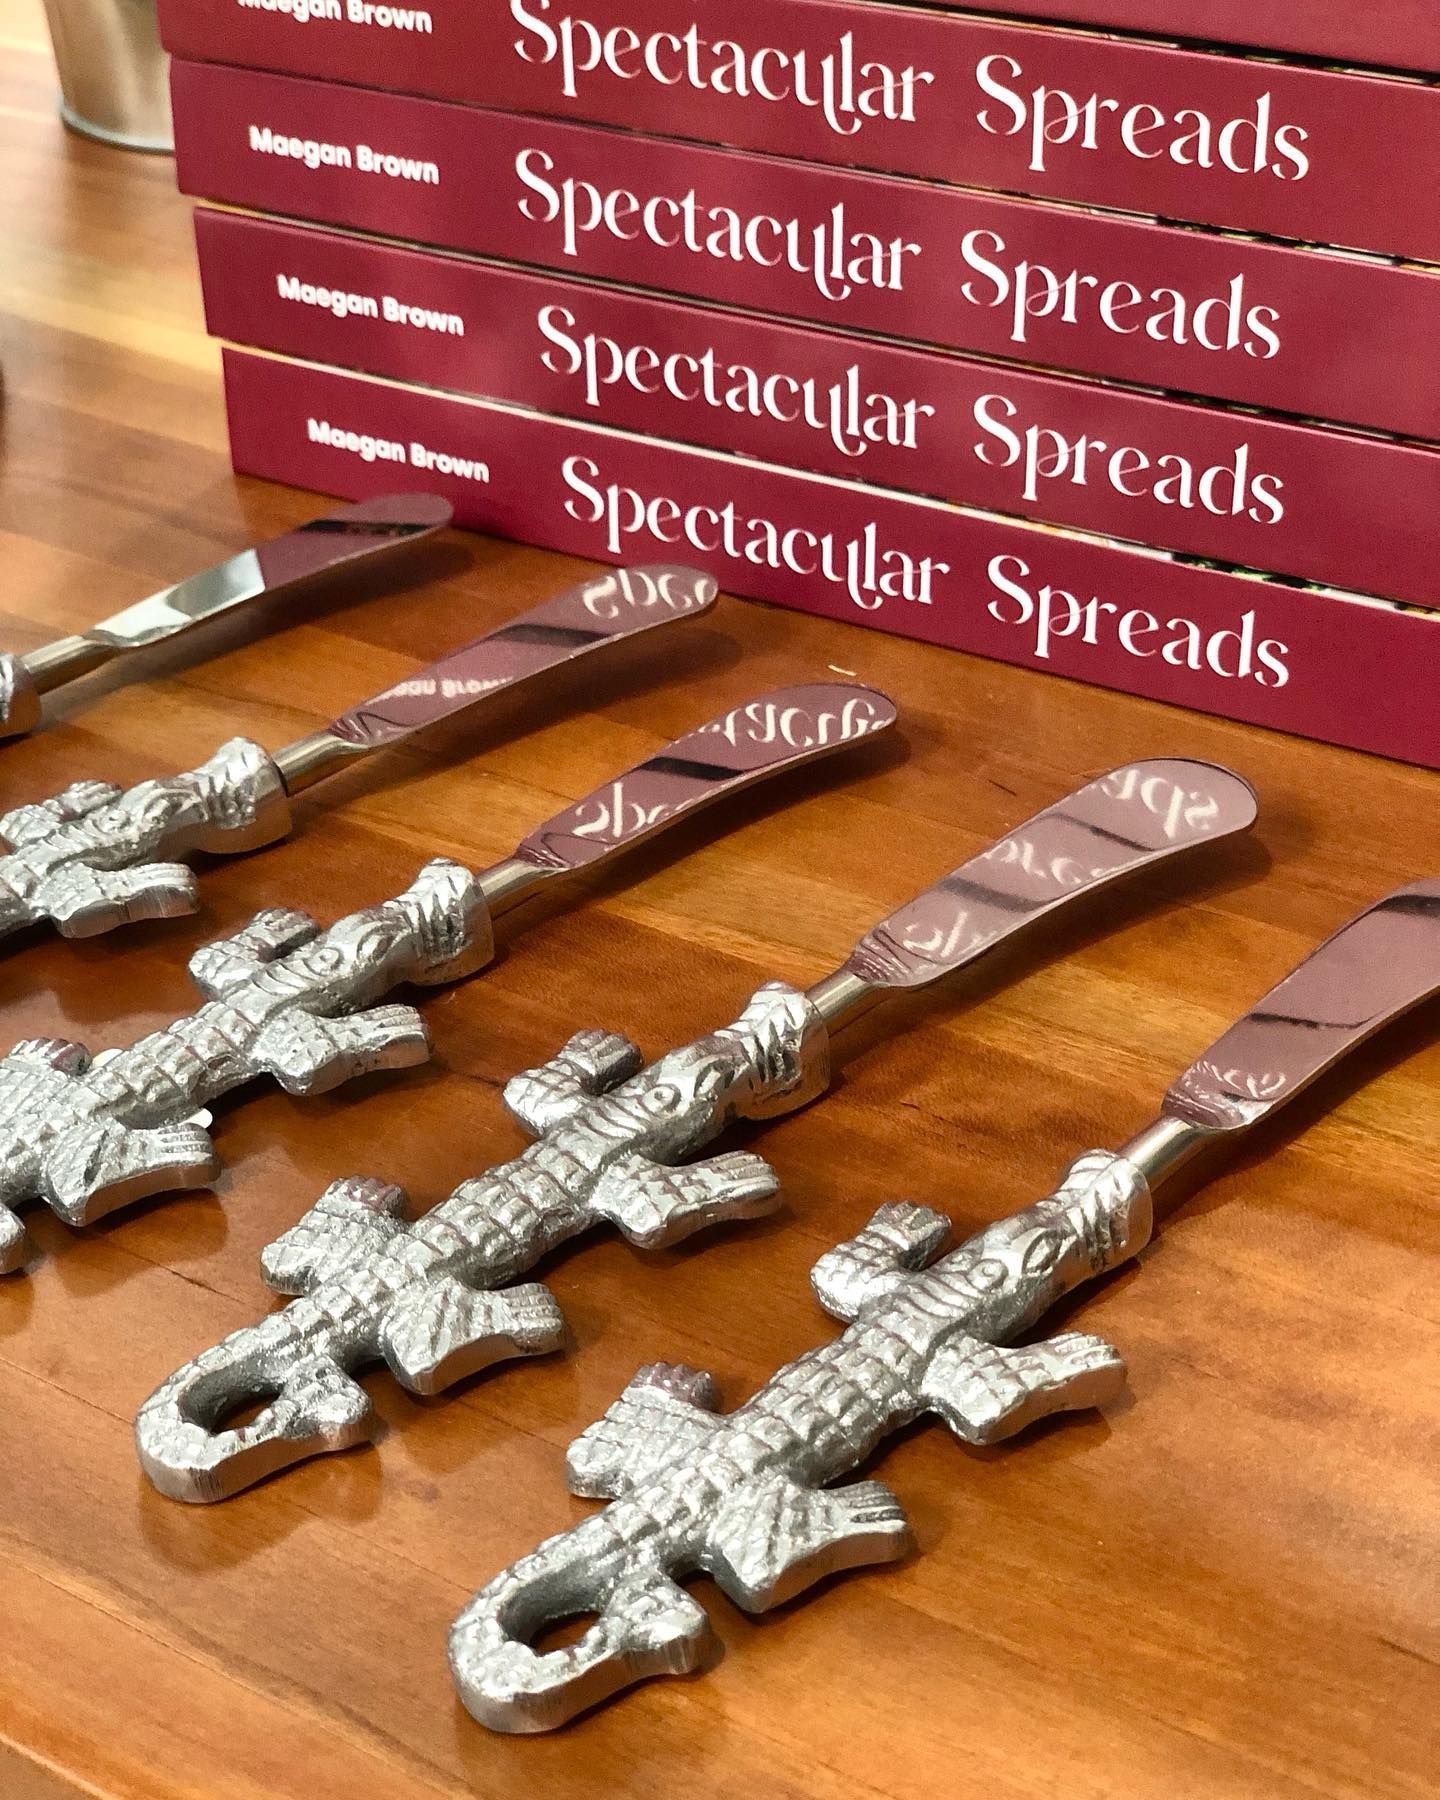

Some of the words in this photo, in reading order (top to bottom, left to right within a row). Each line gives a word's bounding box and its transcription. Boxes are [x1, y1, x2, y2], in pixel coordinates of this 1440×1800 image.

[236, 0, 342, 23] aegan
[346, 0, 433, 35] Brown
[509, 0, 935, 136] Spectacular
[975, 53, 1310, 181] Spreads
[249, 125, 352, 169] Maegan
[355, 144, 440, 185] Brown
[514, 148, 922, 301] Spectacular
[960, 229, 1281, 360] Spreads
[277, 274, 378, 318] Maegan
[382, 296, 465, 337] Brown
[537, 304, 935, 457] Spectacular
[973, 394, 1284, 525] Spreads
[307, 418, 406, 463] Maegan
[410, 442, 490, 483] Brown
[561, 455, 951, 610] Spectacular
[987, 554, 1290, 688] Spreads
